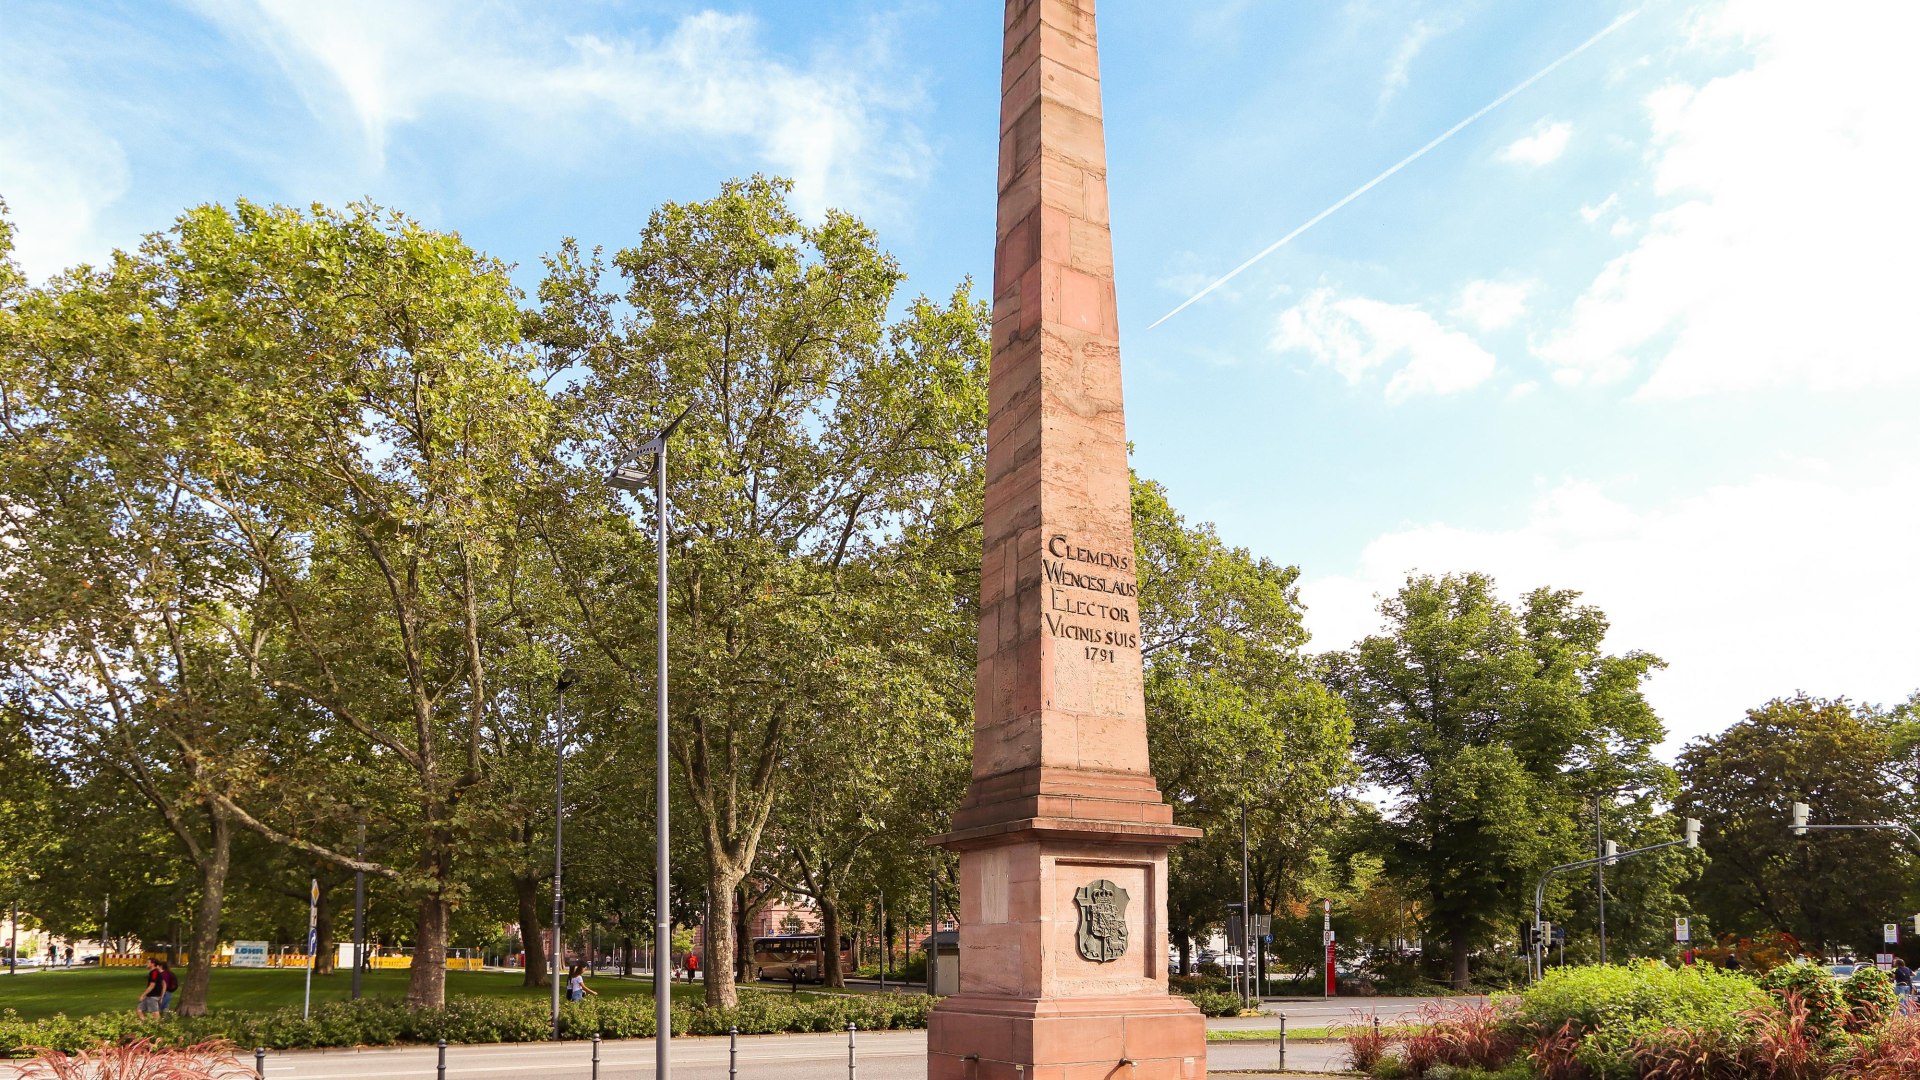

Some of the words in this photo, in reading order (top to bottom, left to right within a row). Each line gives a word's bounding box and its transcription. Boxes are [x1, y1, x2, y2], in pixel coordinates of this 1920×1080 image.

[1048, 535, 1128, 569] CLEMENS
[1043, 559, 1136, 597] WENCESLAUS
[1051, 587, 1130, 622] ELECTOR
[1045, 612, 1101, 643] VICINIS
[1105, 631, 1136, 649] SUIS
[1085, 646, 1115, 663] 1791
